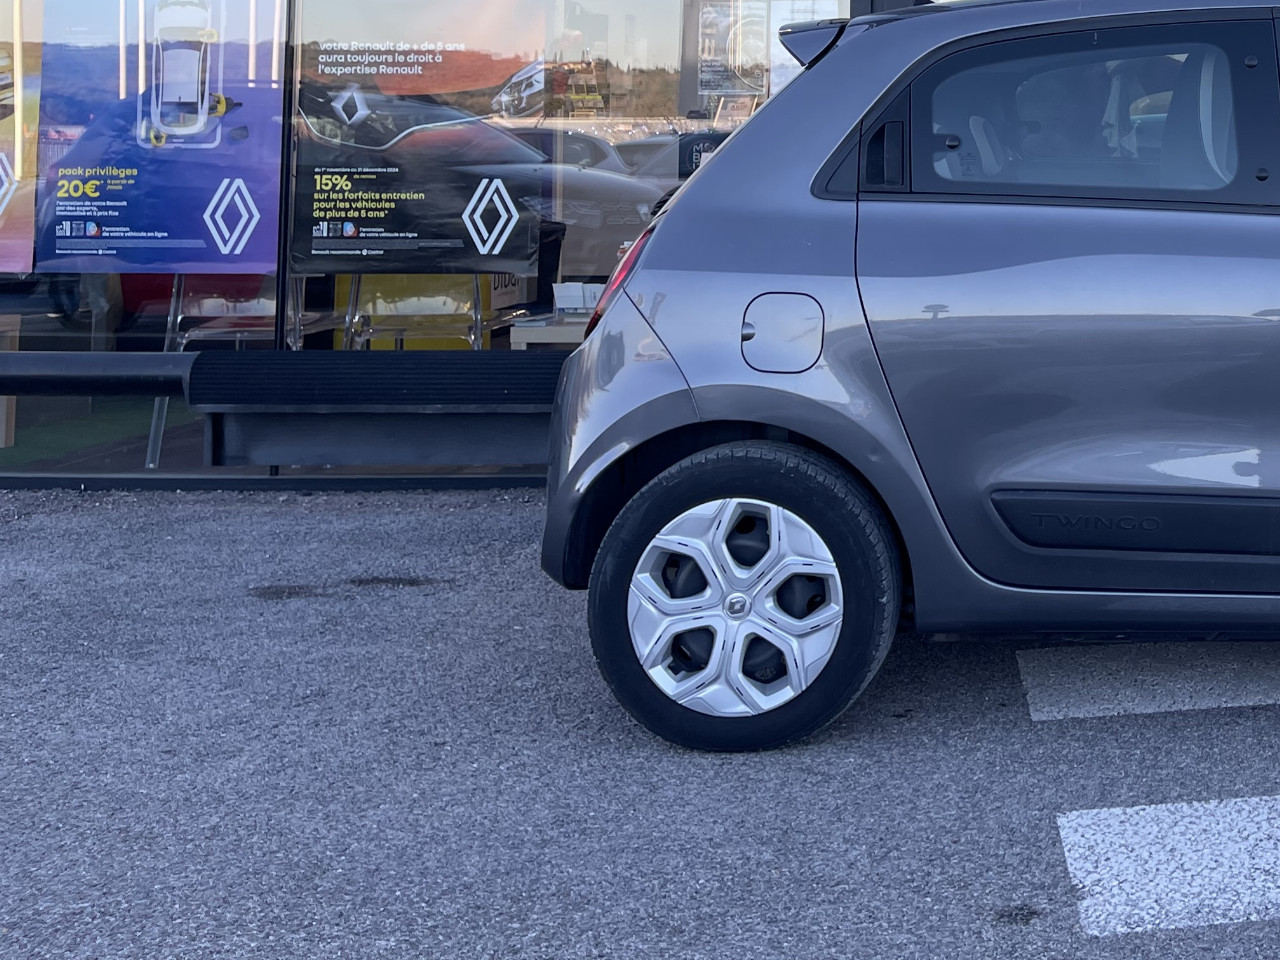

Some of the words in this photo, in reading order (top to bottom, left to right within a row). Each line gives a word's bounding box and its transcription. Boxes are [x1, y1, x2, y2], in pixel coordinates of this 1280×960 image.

[319, 42, 348, 50] votre
[351, 41, 394, 50] Renault
[396, 42, 410, 50] de
[420, 42, 435, 50] de
[437, 42, 443, 50] 5
[319, 55, 344, 63] aura
[347, 54, 392, 64] toujours
[395, 53, 405, 63] le
[407, 53, 433, 63] droit
[435, 53, 442, 63] à
[318, 65, 377, 76] l'expertise
[379, 65, 423, 75] Renault
[58, 166, 84, 177] pack
[85, 166, 138, 177] privilèges
[314, 174, 352, 190] 15%
[345, 191, 380, 199] forfaits
[381, 191, 425, 199] entretien
[313, 202, 335, 210] pour
[337, 200, 350, 208] les
[351, 200, 395, 208] véhicules
[326, 210, 346, 218] plus
[1030, 512, 1161, 531] TWINGO
